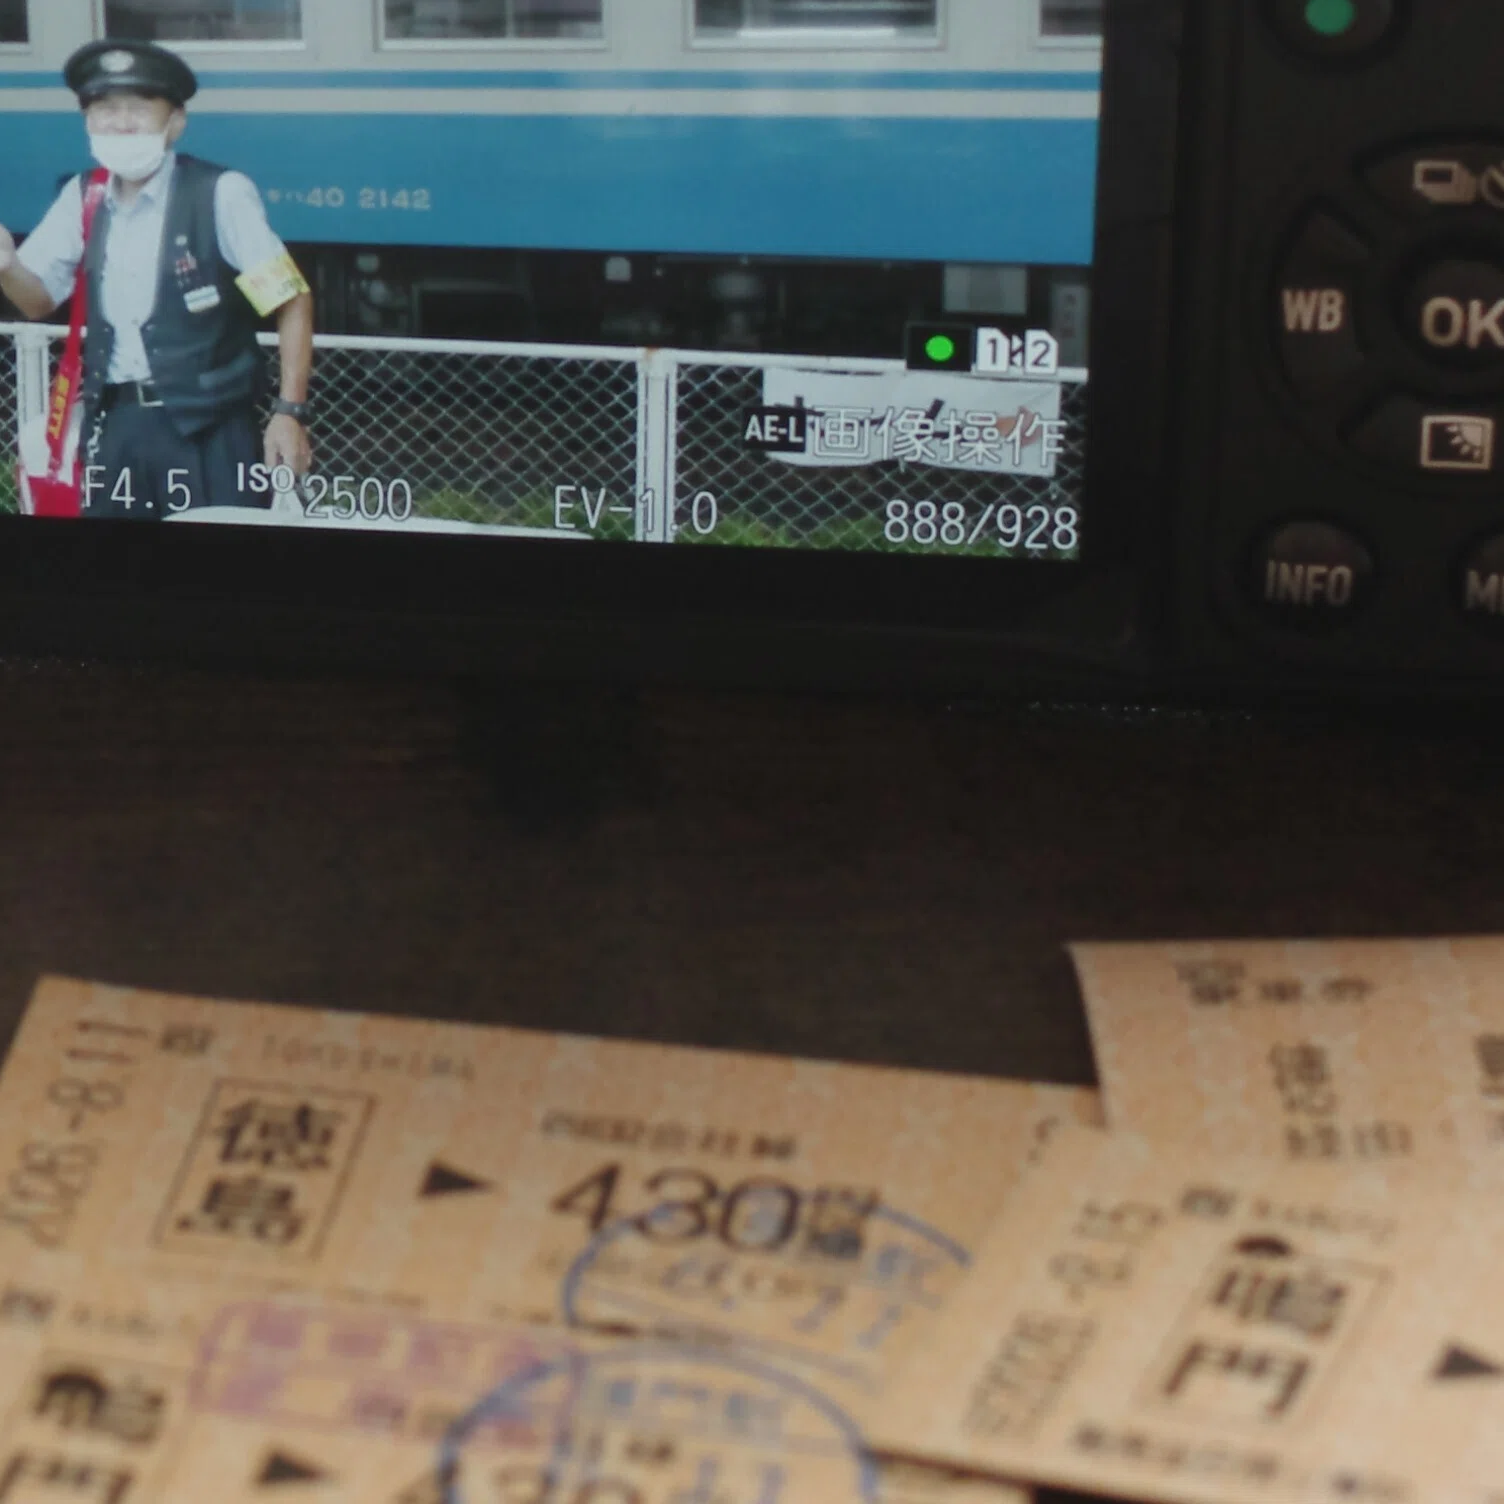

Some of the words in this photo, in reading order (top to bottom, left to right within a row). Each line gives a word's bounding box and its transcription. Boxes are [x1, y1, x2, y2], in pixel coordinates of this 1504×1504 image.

[359, 187, 431, 210] 2142
[1282, 288, 1344, 333] WB
[744, 414, 804, 444] AE-L
[810, 405, 1068, 468] 画像操作
[84, 466, 192, 511] F4.5
[237, 462, 294, 494] ISO
[303, 474, 413, 522] 2500
[884, 499, 1079, 550] 888/928
[1265, 560, 1352, 608] INFO
